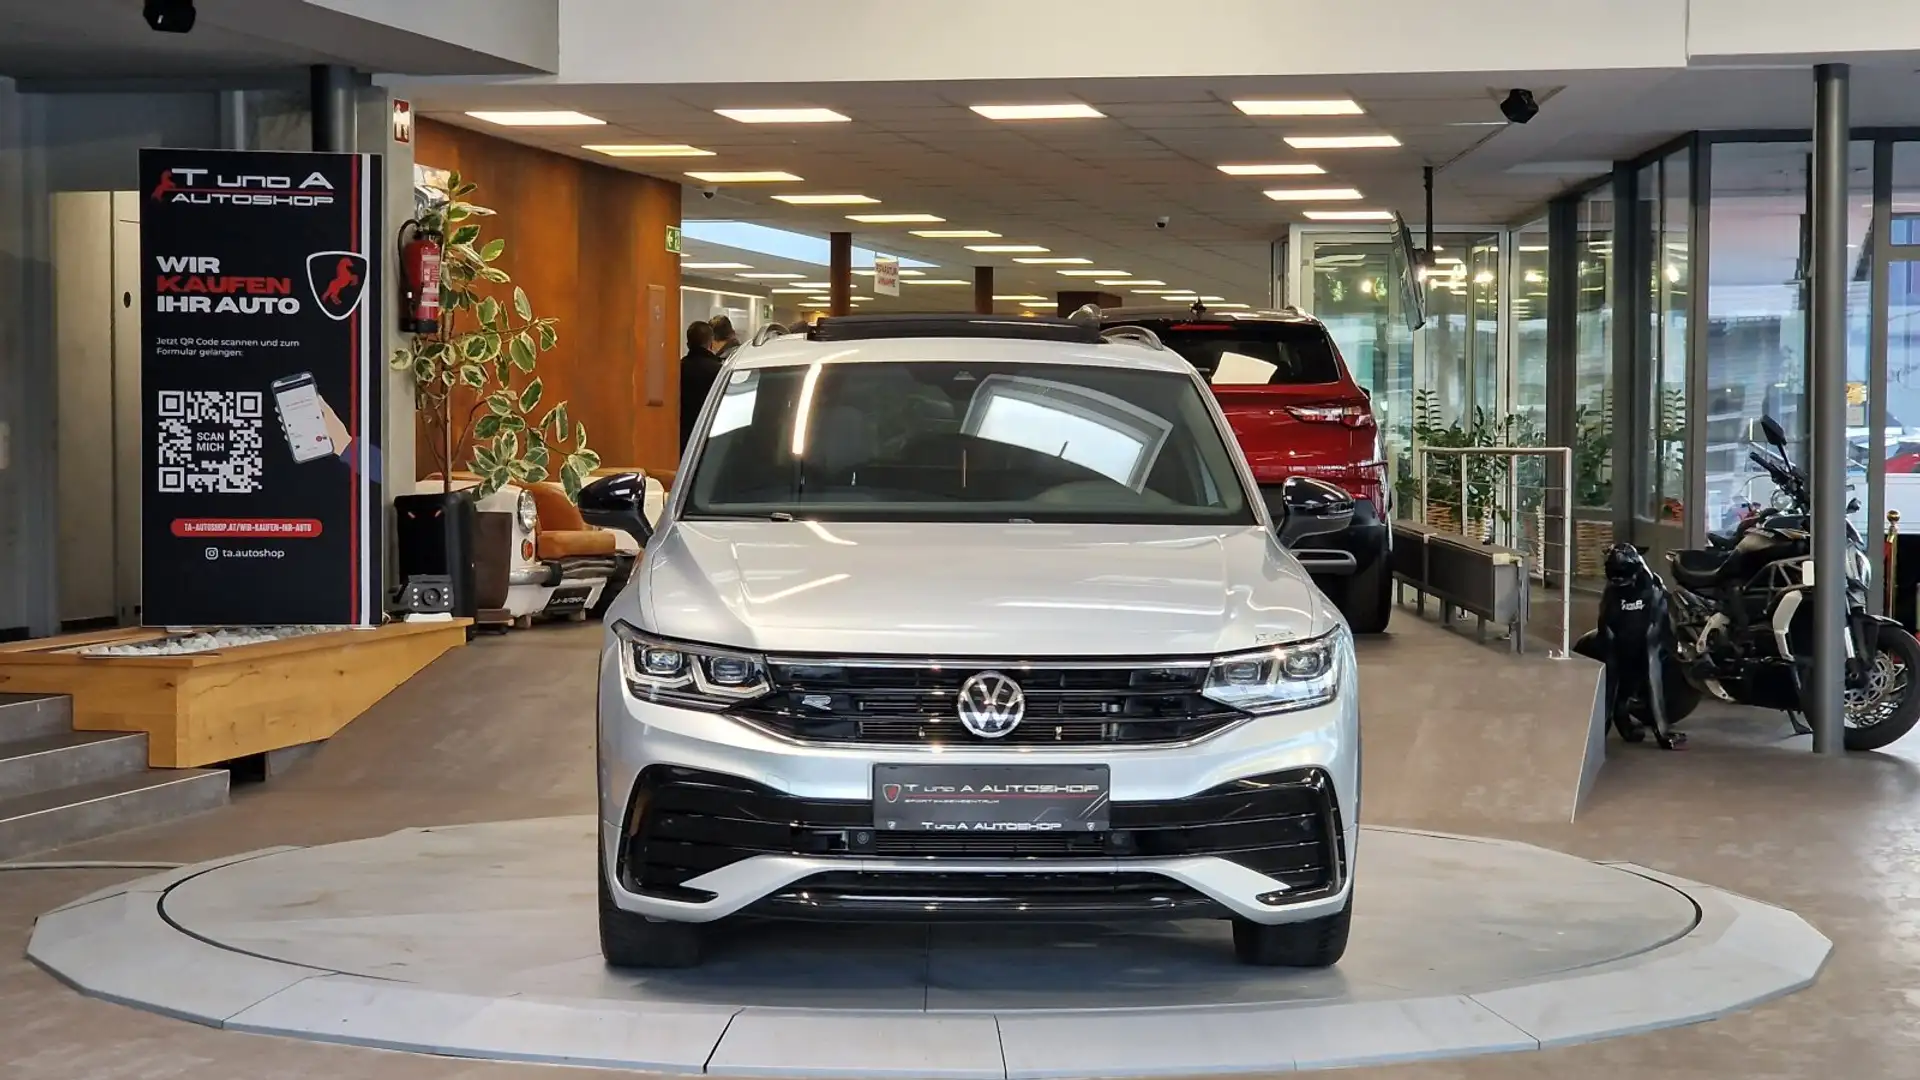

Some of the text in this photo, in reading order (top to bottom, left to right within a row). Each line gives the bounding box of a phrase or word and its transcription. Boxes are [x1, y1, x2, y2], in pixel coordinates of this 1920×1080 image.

[171, 168, 208, 186] T
[298, 171, 334, 190] A
[171, 193, 334, 207] AUTOSHOP
[156, 255, 221, 274] WIR
[156, 275, 292, 295] KAUFEN
[156, 295, 300, 315] IHR AUTO
[156, 337, 178, 345] Jetzt
[180, 337, 194, 347] QR
[195, 337, 219, 346] Code
[220, 339, 258, 347] scannen
[260, 339, 278, 347] und
[156, 347, 197, 356] Formular
[196, 432, 225, 441] SCAN
[196, 442, 225, 452] MICH
[222, 548, 285, 560] ta.autoshop
[904, 783, 919, 793] T
[960, 784, 975, 793] A
[980, 784, 1099, 793] AUTOSHOP
[974, 822, 1063, 831] AUTOSHOP
